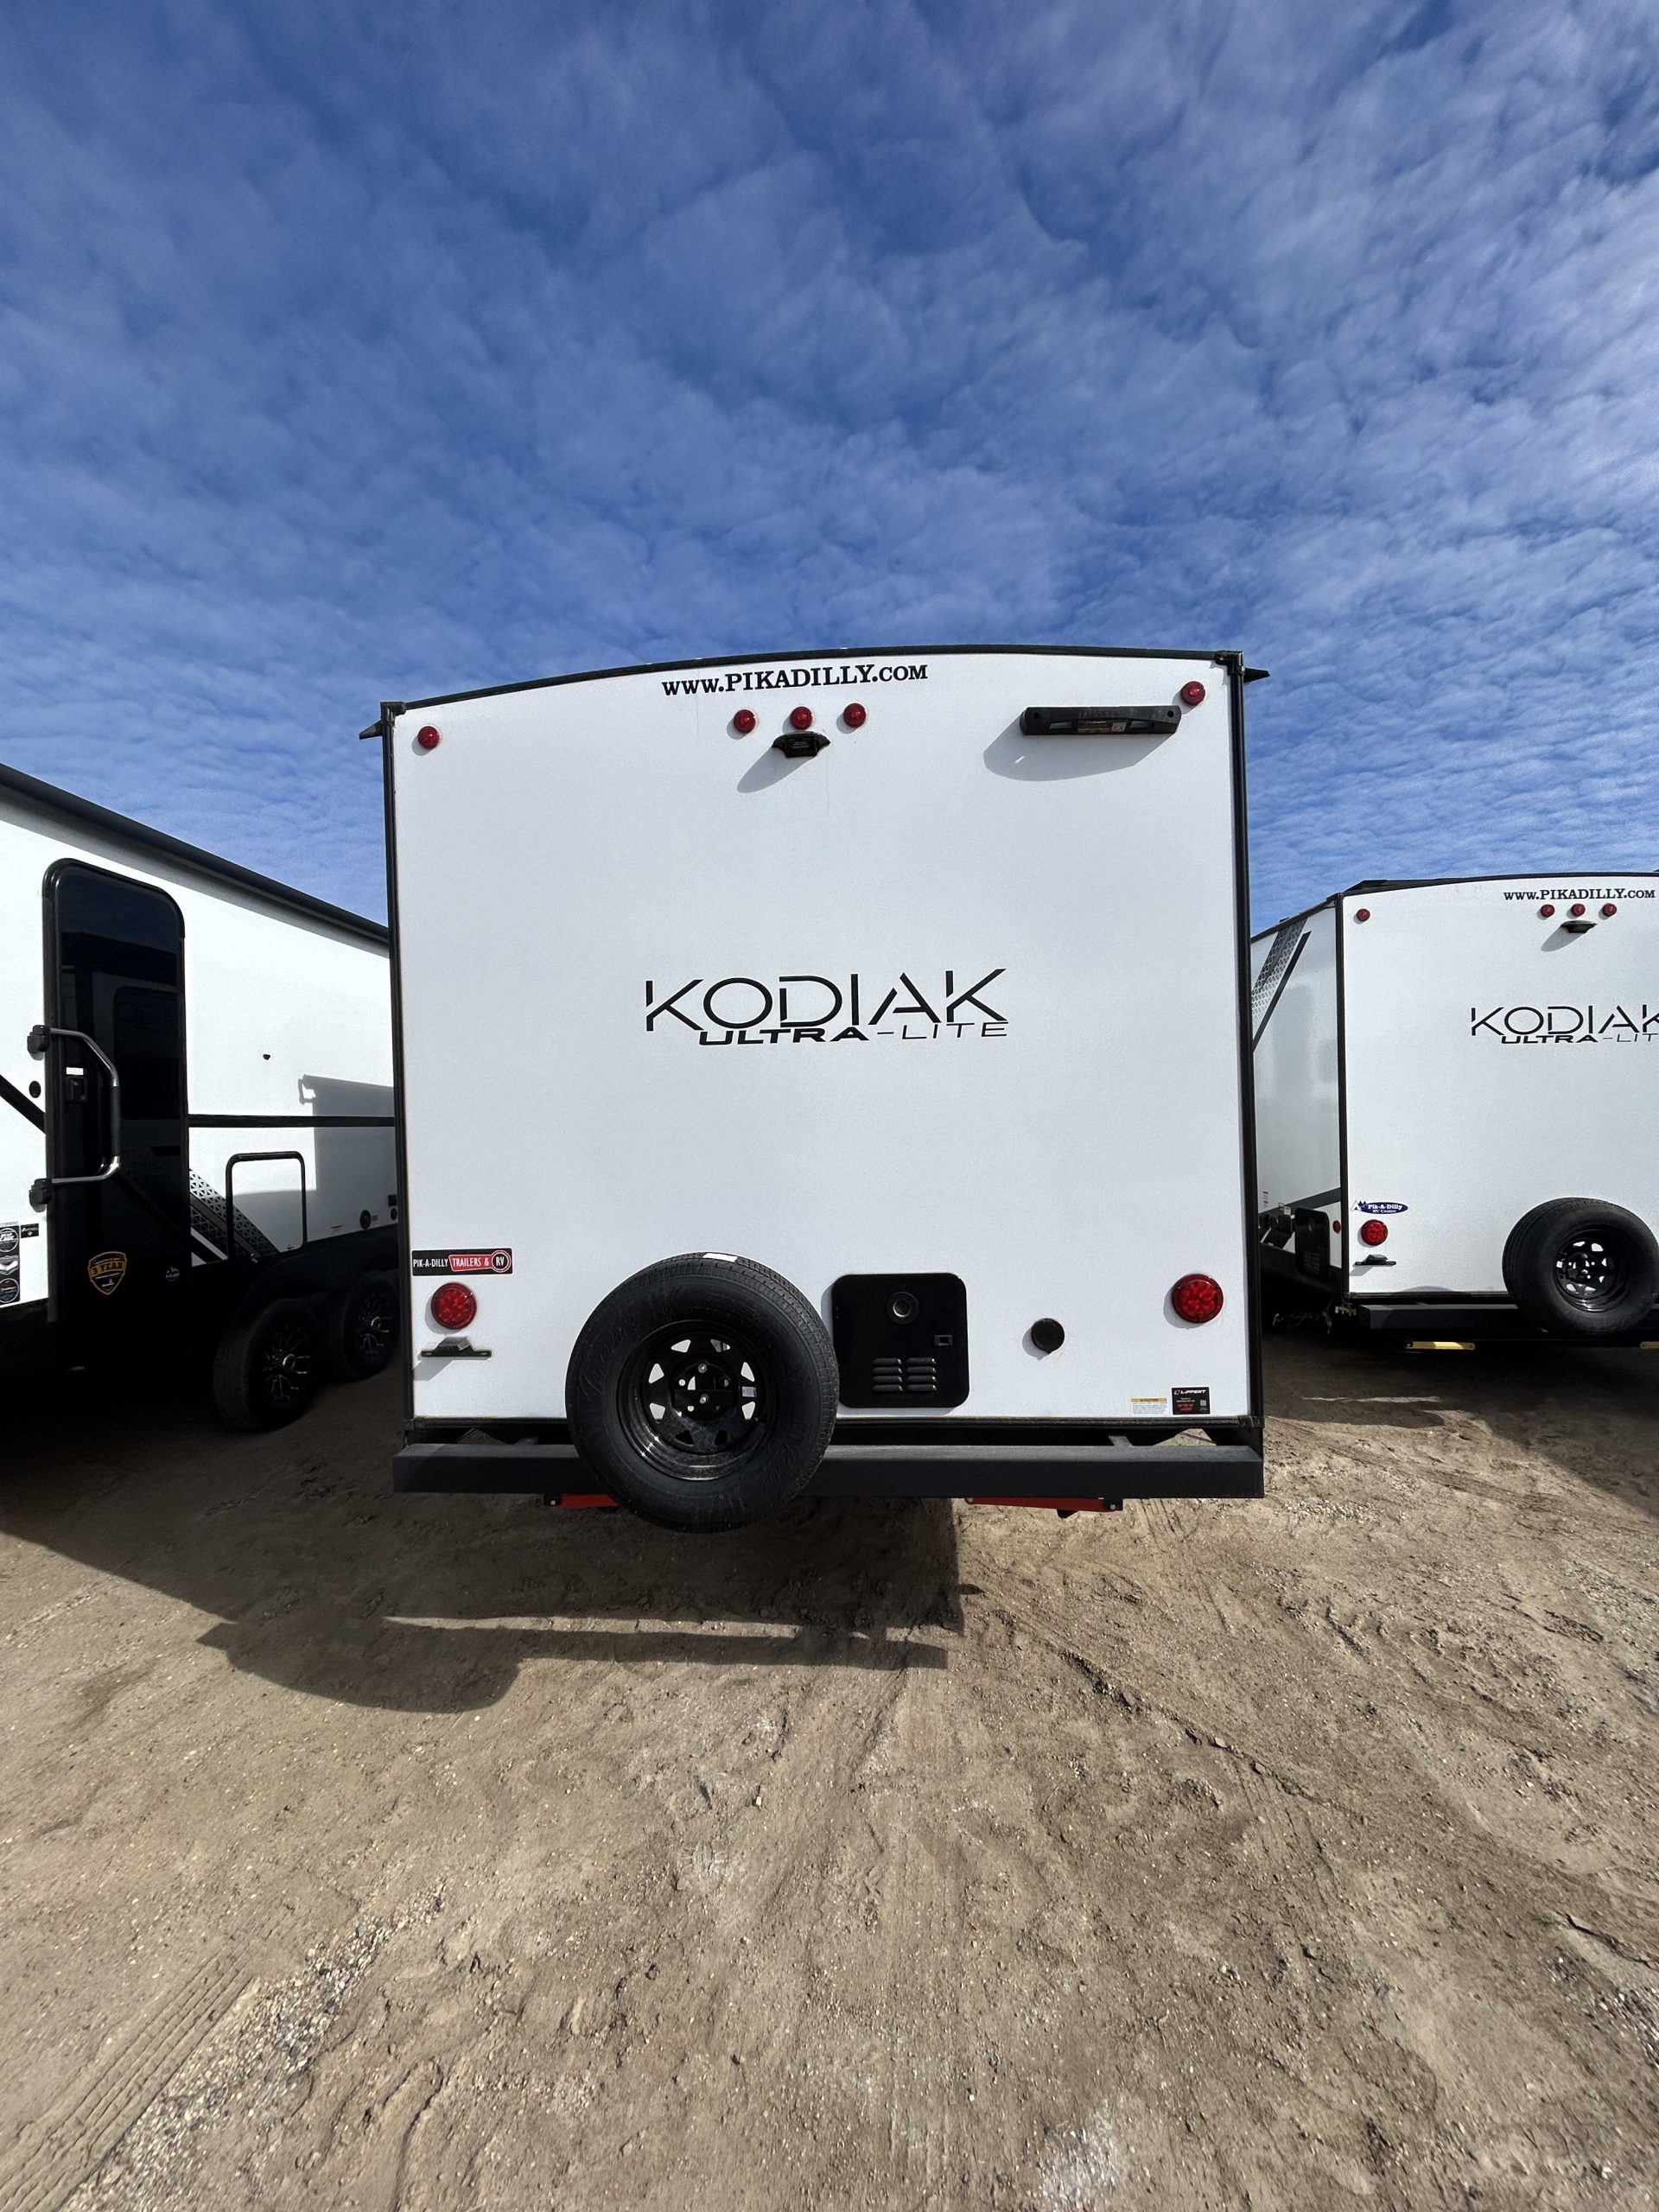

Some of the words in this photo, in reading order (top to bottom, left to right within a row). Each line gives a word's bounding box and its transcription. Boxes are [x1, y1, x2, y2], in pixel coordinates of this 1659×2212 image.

[645, 968, 1009, 1032] KODIAK
[698, 1021, 1009, 1046] ULTRA-LITE
[1501, 1033, 1659, 1045] ULTRA-LIT
[99, 1262, 124, 1273] YEAR
[413, 1258, 448, 1268] PIK-A-DILLY
[452, 1257, 482, 1268] TRAILERS
[484, 1257, 490, 1267] &
[495, 1256, 505, 1267] RV
